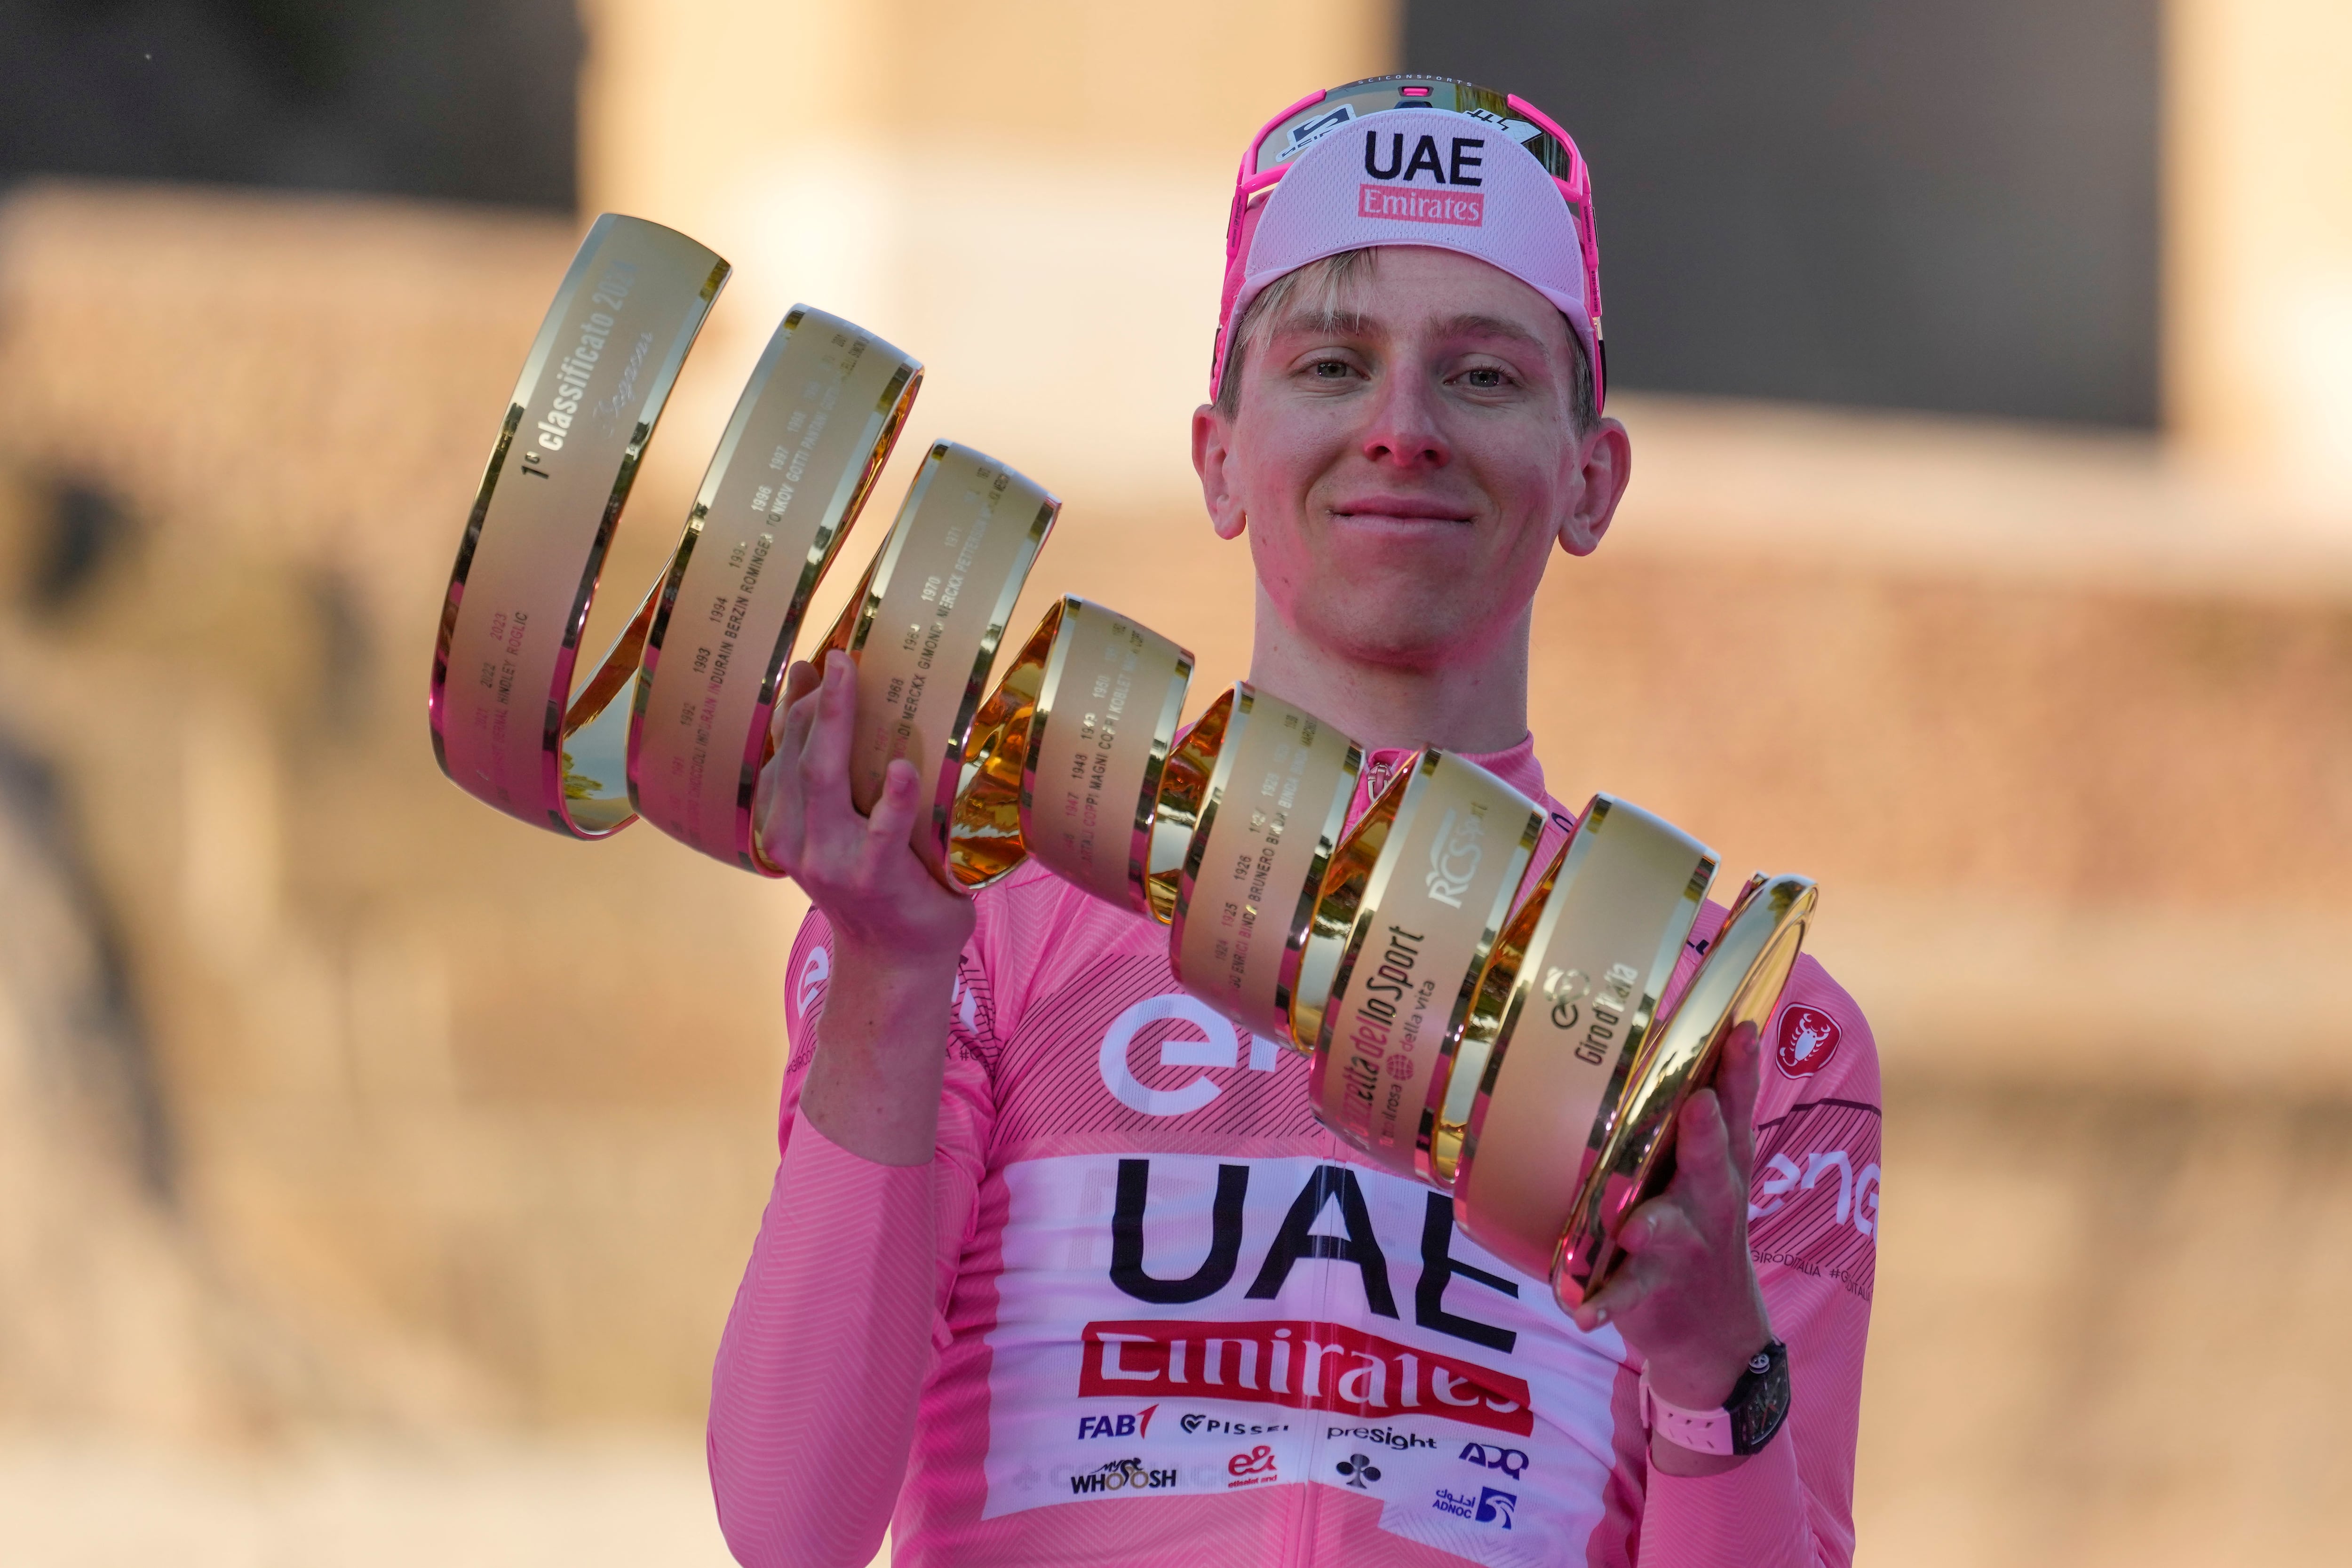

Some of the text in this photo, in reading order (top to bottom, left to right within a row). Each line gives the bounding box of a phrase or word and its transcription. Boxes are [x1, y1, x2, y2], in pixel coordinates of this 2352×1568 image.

[1358, 74, 1472, 87] SCICONSPORTS
[1365, 130, 1485, 186] UAE
[1364, 189, 1479, 221] Emirates
[538, 312, 614, 452] classificato
[751, 485, 772, 512] 1996
[769, 445, 789, 471] 1997
[708, 641, 735, 695] INDURAIN
[725, 597, 749, 639] BERZIN
[766, 484, 795, 527] TONKOV
[786, 450, 808, 482] GOTTI
[480, 662, 497, 689] 2022
[490, 613, 508, 641] 2023
[497, 660, 516, 705] HINDLEY
[507, 611, 528, 655] ROGLIC
[680, 702, 696, 727] 1992
[693, 647, 712, 674] 1993
[709, 597, 728, 624] 1994
[886, 678, 905, 705] 1968
[921, 575, 942, 603] 1970
[903, 672, 927, 723] MERCKX
[939, 573, 964, 621] MERCKX
[1072, 754, 1088, 780] 1948
[1082, 793, 1100, 829] COPPI
[1092, 754, 1109, 792] MAGNI
[1066, 792, 1080, 818] 1947
[1221, 902, 1238, 928] 1925
[1233, 854, 1253, 882] 1926
[1232, 941, 1250, 977] ENRICI
[1248, 849, 1275, 903] BRUNERO
[1277, 777, 1300, 810] BINDA
[1426, 837, 1482, 909] RCS
[1366, 925, 1425, 1002] Sport
[1349, 998, 1397, 1059] dello
[1399, 979, 1435, 1052] della vita
[1386, 1083, 1403, 1110] rosa
[1109, 1159, 1519, 1354] UAE
[1459, 1442, 1530, 1481] ADQ
[1432, 1499, 1473, 1520] ADNOC
